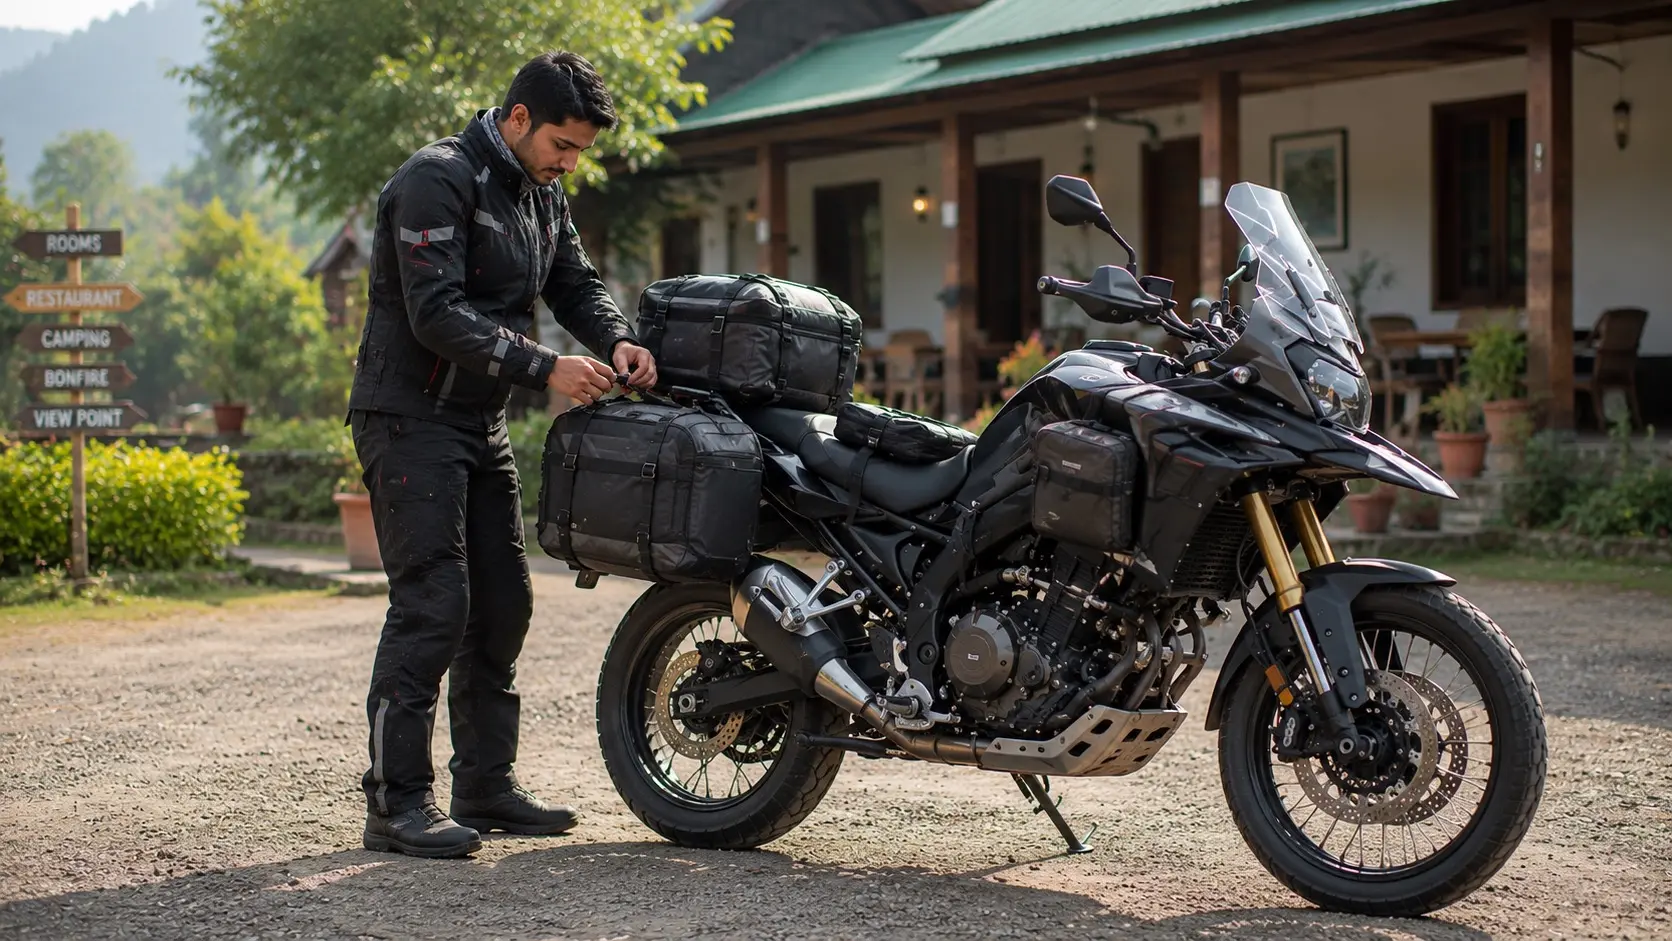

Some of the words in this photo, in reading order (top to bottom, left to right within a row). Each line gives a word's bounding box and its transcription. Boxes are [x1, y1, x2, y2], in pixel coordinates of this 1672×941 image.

[46, 234, 101, 253] ROOMS
[26, 289, 122, 307] RESTAURANT
[41, 329, 111, 348] CAMPING
[44, 369, 108, 387] BONFIRE
[33, 408, 73, 428] VIEW
[77, 408, 122, 427] POINT
